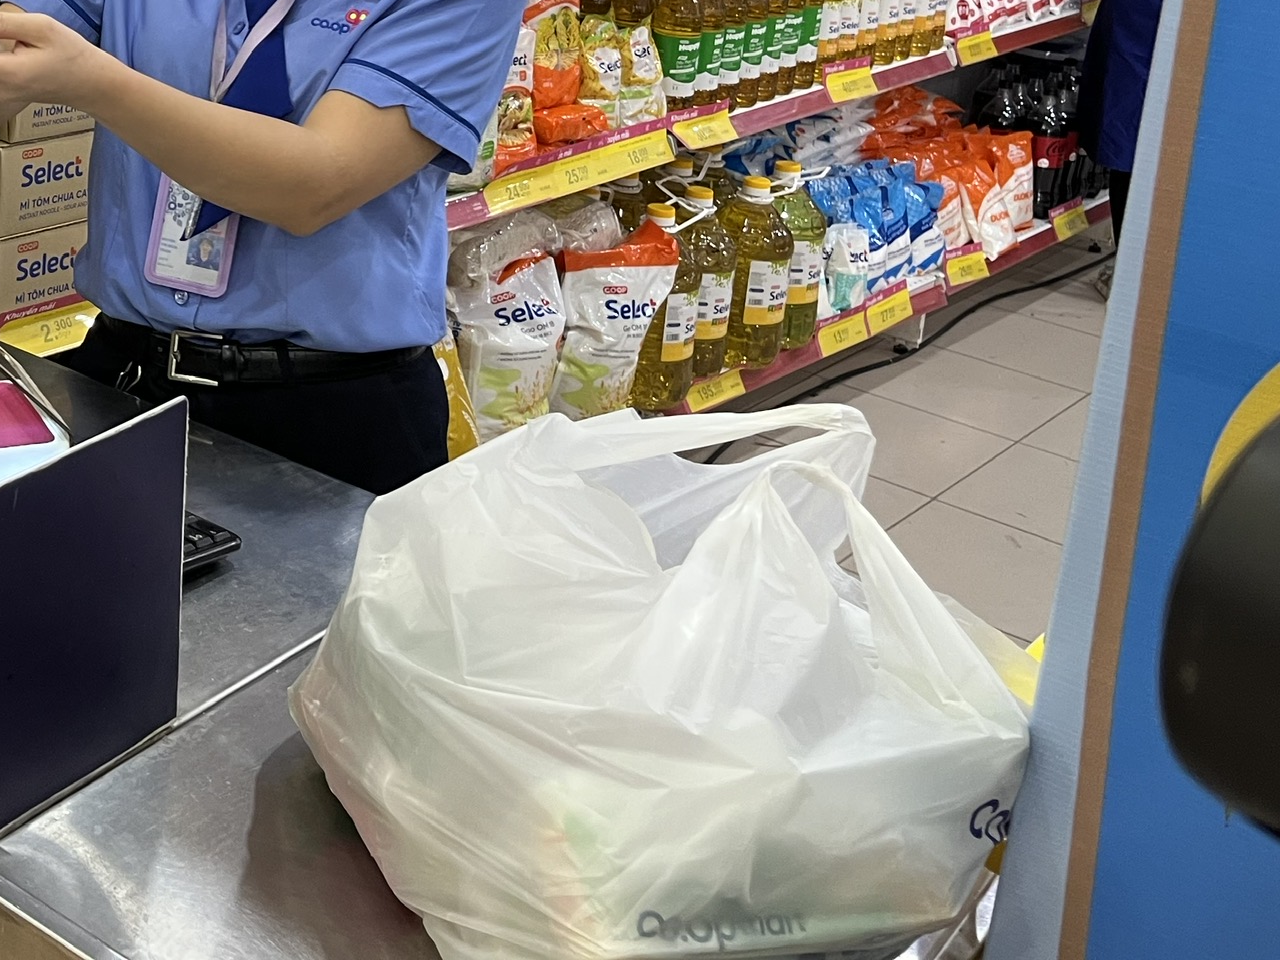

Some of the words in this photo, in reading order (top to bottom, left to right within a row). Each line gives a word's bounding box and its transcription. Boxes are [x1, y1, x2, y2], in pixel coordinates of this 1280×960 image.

[33, 106, 46, 119] MÌ
[46, 104, 64, 118] TÔM
[22, 148, 43, 159] COOP
[20, 155, 84, 188] Select
[19, 197, 32, 212] MÌ
[32, 194, 51, 208] TÔM
[51, 192, 74, 206] CHUA
[73, 189, 88, 201] CA
[39, 206, 62, 217] NOODLE
[63, 203, 77, 213] SOUR
[17, 241, 39, 253] COOP
[16, 246, 78, 282] Select
[15, 293, 25, 305] MÌ
[27, 288, 46, 302] TÔM
[47, 283, 70, 296] CHUA
[491, 291, 516, 304] COOP
[603, 286, 627, 295] COOP
[4, 305, 38, 322] Khuyến
[39, 300, 56, 315] mãi
[536, 322, 549, 332] OM
